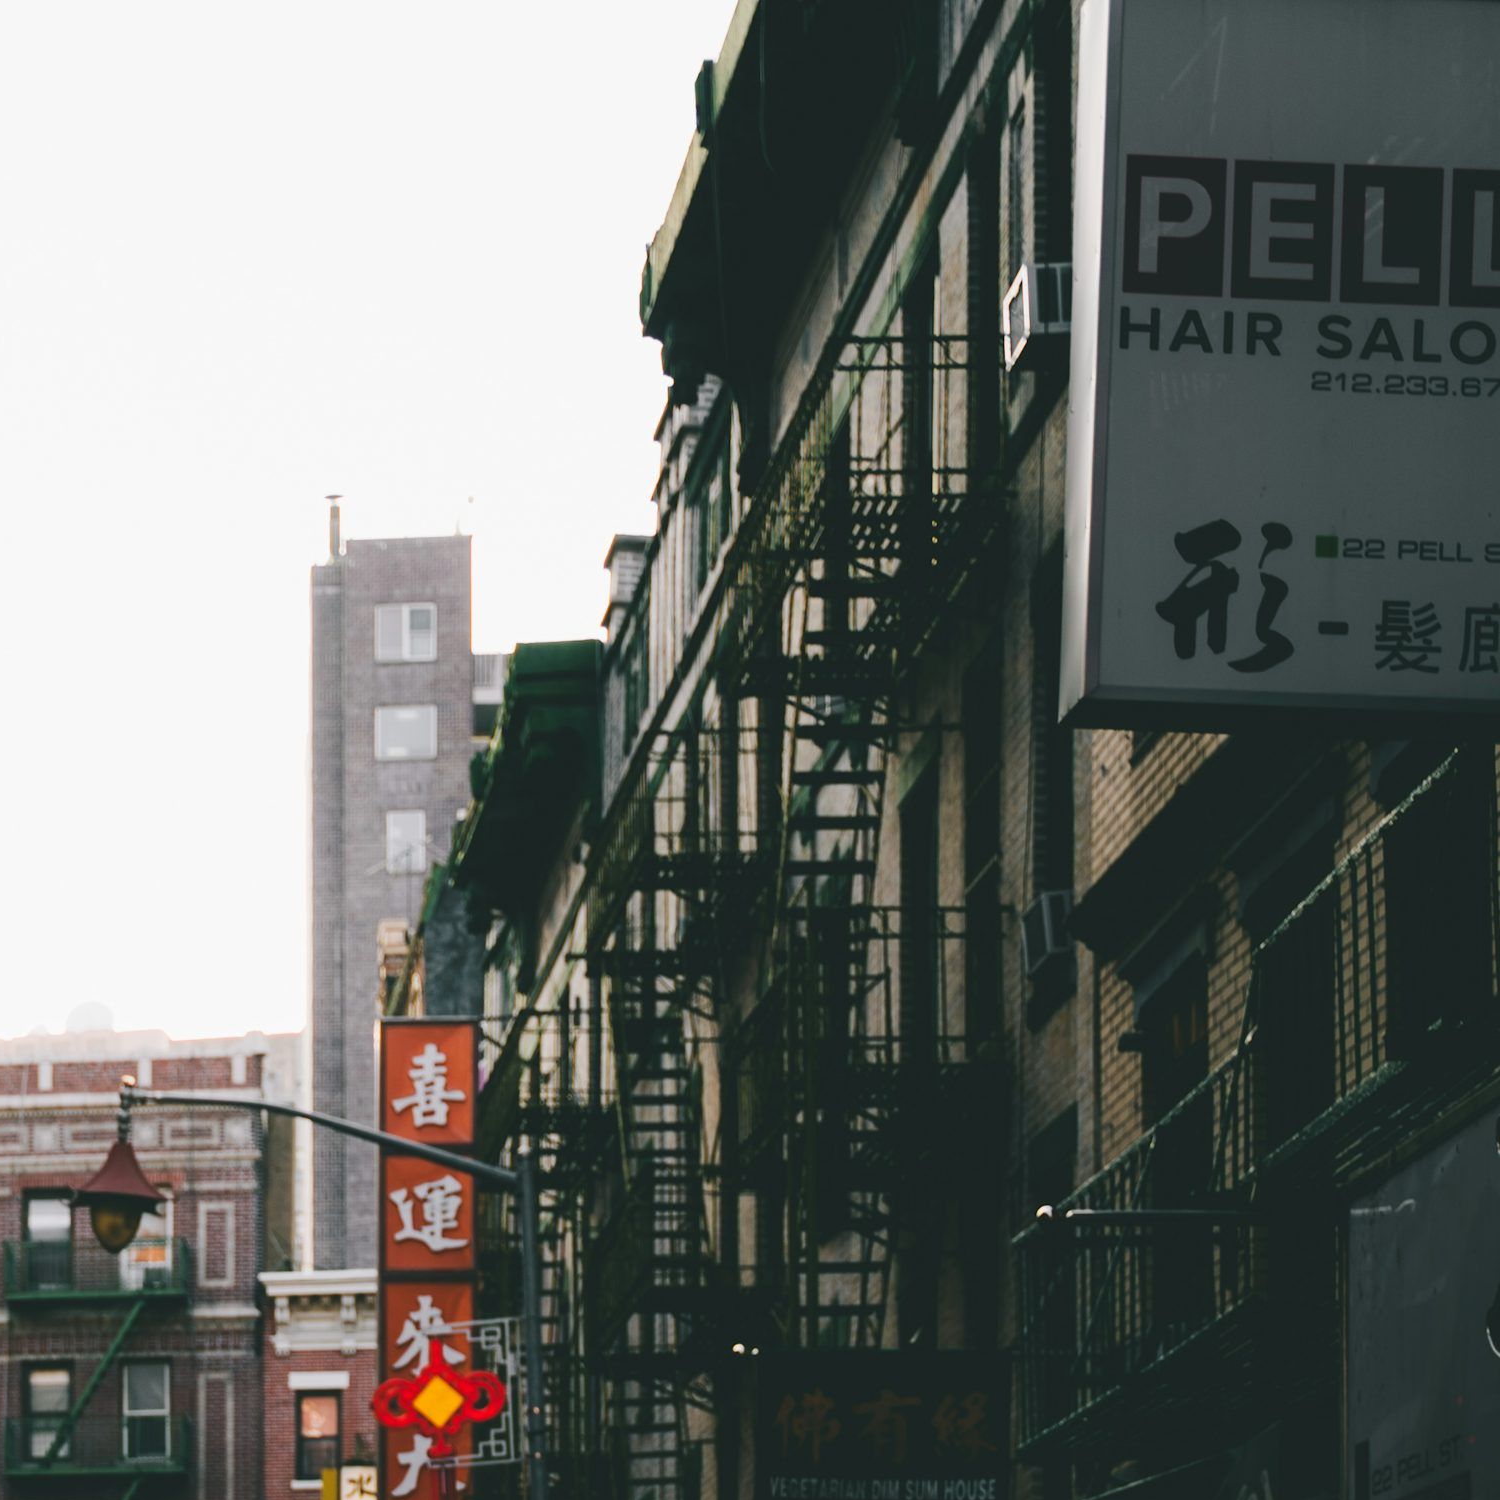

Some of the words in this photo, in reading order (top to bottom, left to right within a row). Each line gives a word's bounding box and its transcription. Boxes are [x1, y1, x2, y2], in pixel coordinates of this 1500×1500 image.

[1118, 305, 1283, 356] HAIR
[1342, 538, 1385, 559] 22
[1398, 540, 1473, 563] PELL
[1397, 1449, 1435, 1485] PELL
[769, 1476, 867, 1499] VEGETARIAN
[871, 1479, 900, 1500] DIM
[905, 1479, 939, 1500] SUM
[943, 1479, 997, 1500] HOUSE
